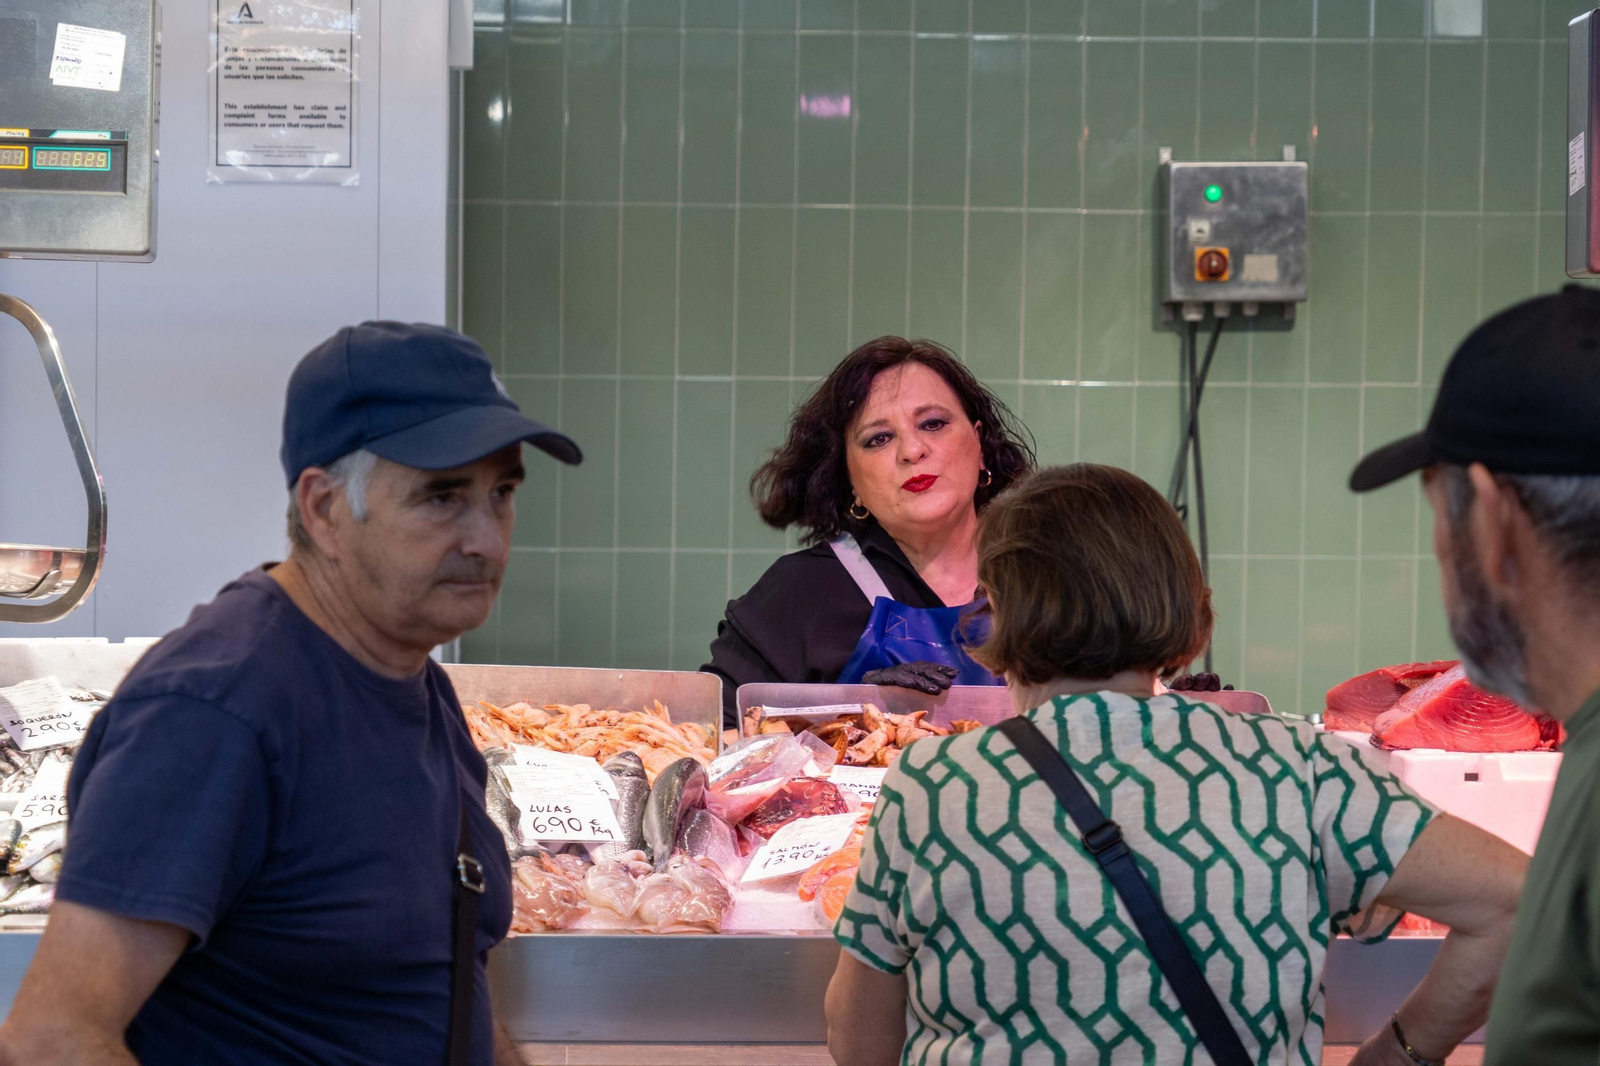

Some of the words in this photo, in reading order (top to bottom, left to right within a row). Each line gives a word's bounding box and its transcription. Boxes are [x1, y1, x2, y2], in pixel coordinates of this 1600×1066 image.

[21, 722, 71, 738] 2.90
[529, 804, 572, 814] LULAS
[533, 816, 582, 834] 6.90
[590, 825, 614, 840] Kg
[761, 849, 815, 870] 13.90
